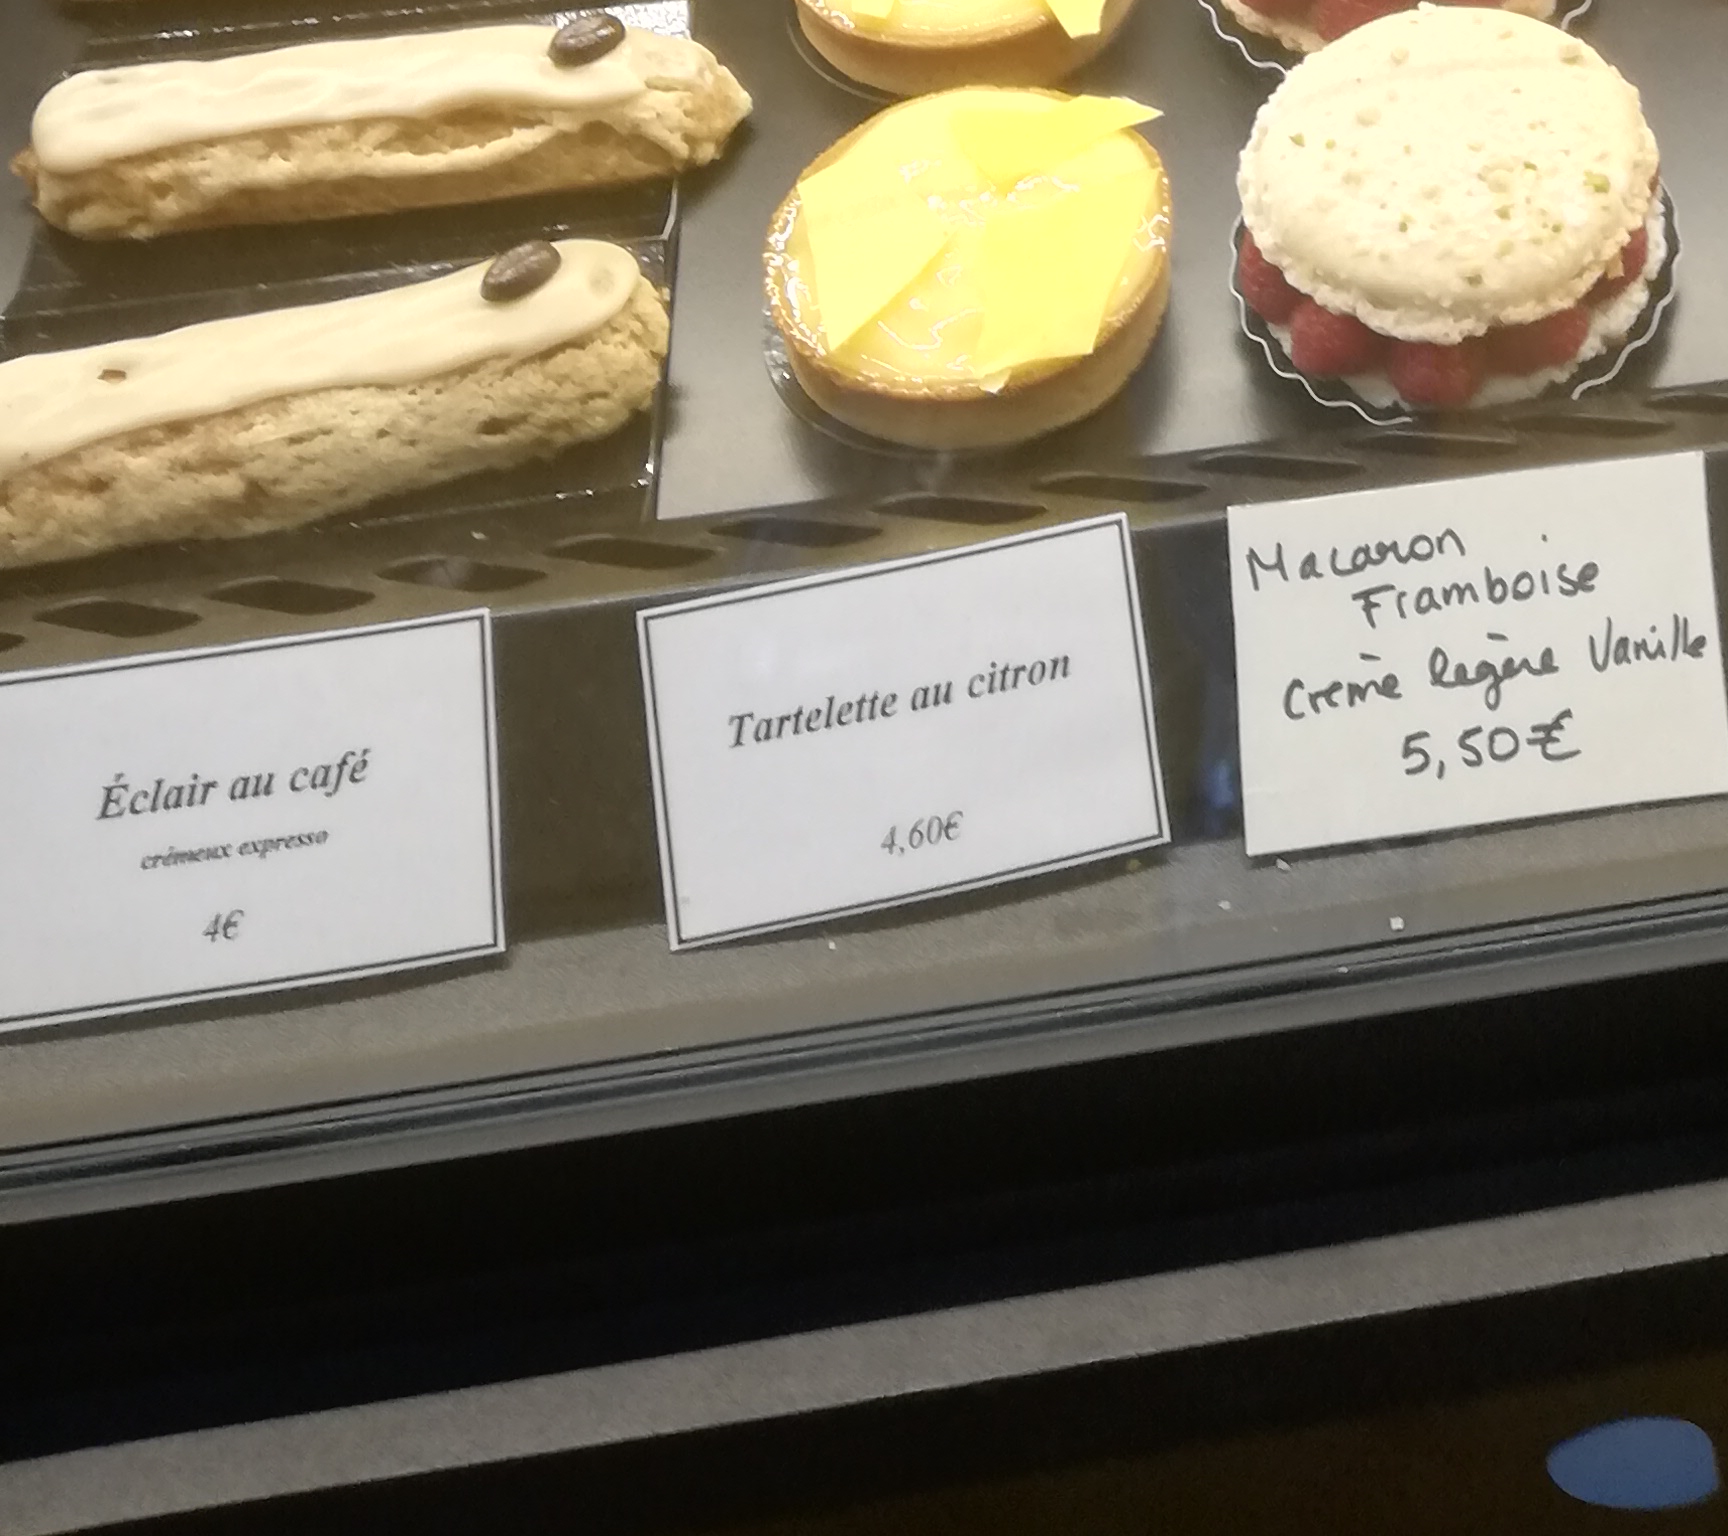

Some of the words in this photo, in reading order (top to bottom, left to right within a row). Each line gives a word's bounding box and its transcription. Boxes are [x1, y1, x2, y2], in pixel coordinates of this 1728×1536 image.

[1246, 528, 1466, 591] Macaron
[1352, 534, 1600, 629] Framboise
[728, 690, 898, 748] Tartelette
[911, 678, 953, 713] au
[968, 653, 1071, 699] citron
[1400, 709, 1581, 779] 5,50€
[95, 772, 219, 821] Éclair
[228, 766, 275, 803] au
[289, 748, 371, 798] café
[140, 842, 233, 870] crémeux
[237, 828, 329, 860] expresso
[202, 909, 245, 943] 4€
